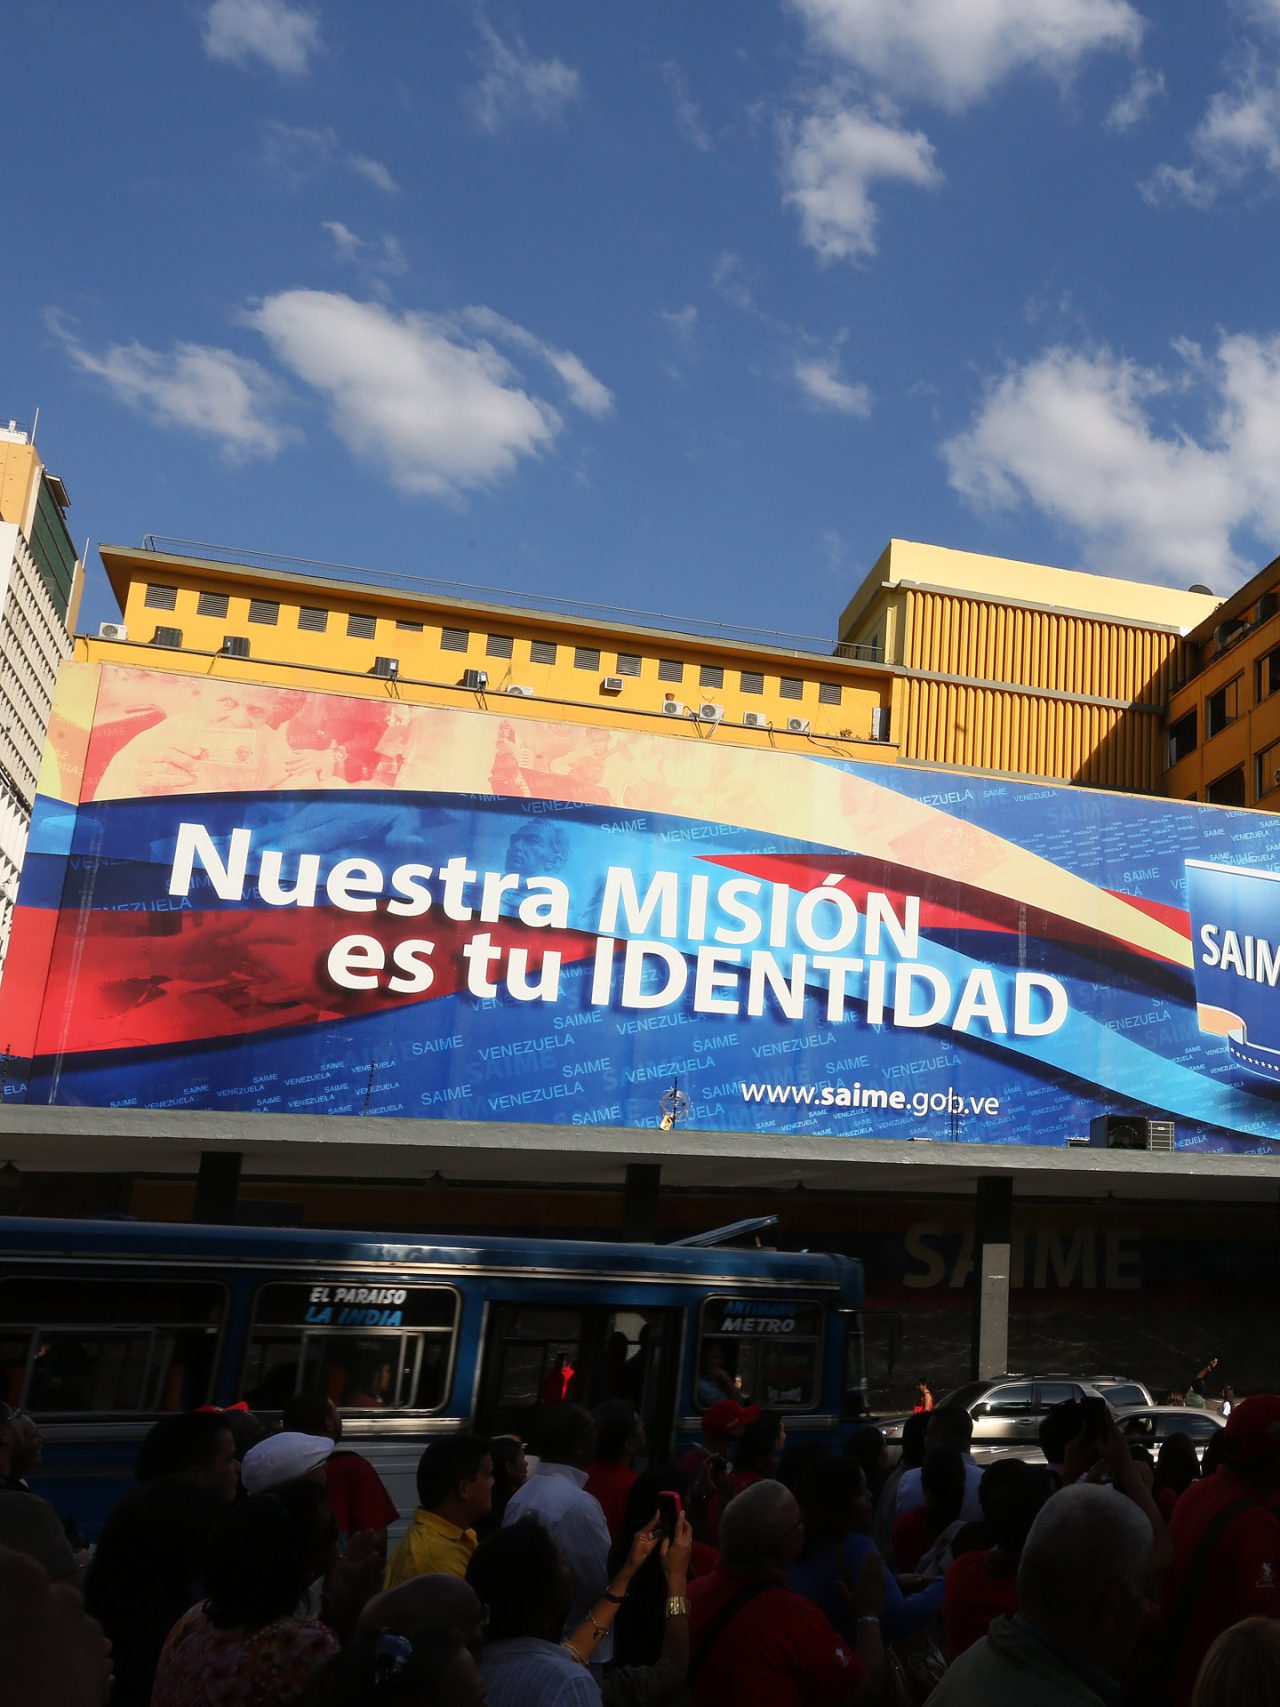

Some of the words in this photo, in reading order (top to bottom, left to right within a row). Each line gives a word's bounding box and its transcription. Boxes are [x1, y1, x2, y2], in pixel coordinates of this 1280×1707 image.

[983, 787, 1007, 798] SAIME
[1013, 790, 1058, 803] VENEZUELA
[601, 819, 647, 834] SAIME
[1259, 819, 1280, 829] SAIME
[1203, 828, 1225, 838] SAIME
[1231, 830, 1270, 842] VENEZUELA
[1124, 867, 1160, 883] SAIME
[168, 822, 570, 929] Nuestra
[598, 866, 920, 958] MISIÓN
[328, 934, 435, 993] es
[463, 933, 562, 1002] tu
[591, 936, 1068, 1036] IDENTIDAD
[554, 1010, 603, 1030] SAIME
[616, 1011, 706, 1036] VENEZUELA
[412, 1035, 464, 1056] SAIME
[479, 1033, 575, 1061] VENEZUELA
[693, 1034, 739, 1053] SAIME
[752, 1033, 836, 1058] VENEZUELA
[321, 1061, 345, 1071] SAIME
[352, 1060, 396, 1073] VENEZUELA
[563, 1058, 612, 1078] SAIME
[626, 1055, 716, 1083] VENEZUELA
[826, 1055, 869, 1074] SAIME
[882, 1054, 961, 1079] VENEZUELA
[253, 1073, 278, 1084] SAIME
[284, 1072, 331, 1086] VENEZUELA
[183, 1084, 209, 1095] SAIME
[216, 1084, 264, 1096] VENEZUELA
[324, 1083, 348, 1093] SAIME
[355, 1082, 400, 1096] VENEZUELA
[421, 1084, 473, 1106] SAIME
[110, 1097, 137, 1108] SAIME
[144, 1096, 195, 1109] VENEZUELA
[257, 1096, 282, 1105] SAIME
[288, 1094, 335, 1108] VENEZUELA
[488, 1082, 584, 1112] VENEZUELA
[741, 1082, 999, 1117] www.saime.gob.ve
[328, 1105, 352, 1115] SAIME
[359, 1104, 404, 1117] VENEZUELA
[572, 1106, 621, 1126] SAIME
[808, 1109, 828, 1118] SAIME
[833, 1108, 869, 1119] VENEZUELA
[756, 1120, 776, 1129] SAIME
[782, 1118, 818, 1131] VENEZUELA
[309, 1287, 330, 1303] EL
[334, 1288, 407, 1304] PARAISO
[304, 1306, 333, 1323] LA
[337, 1308, 404, 1326] INDIA
[721, 1318, 796, 1332] METRO
